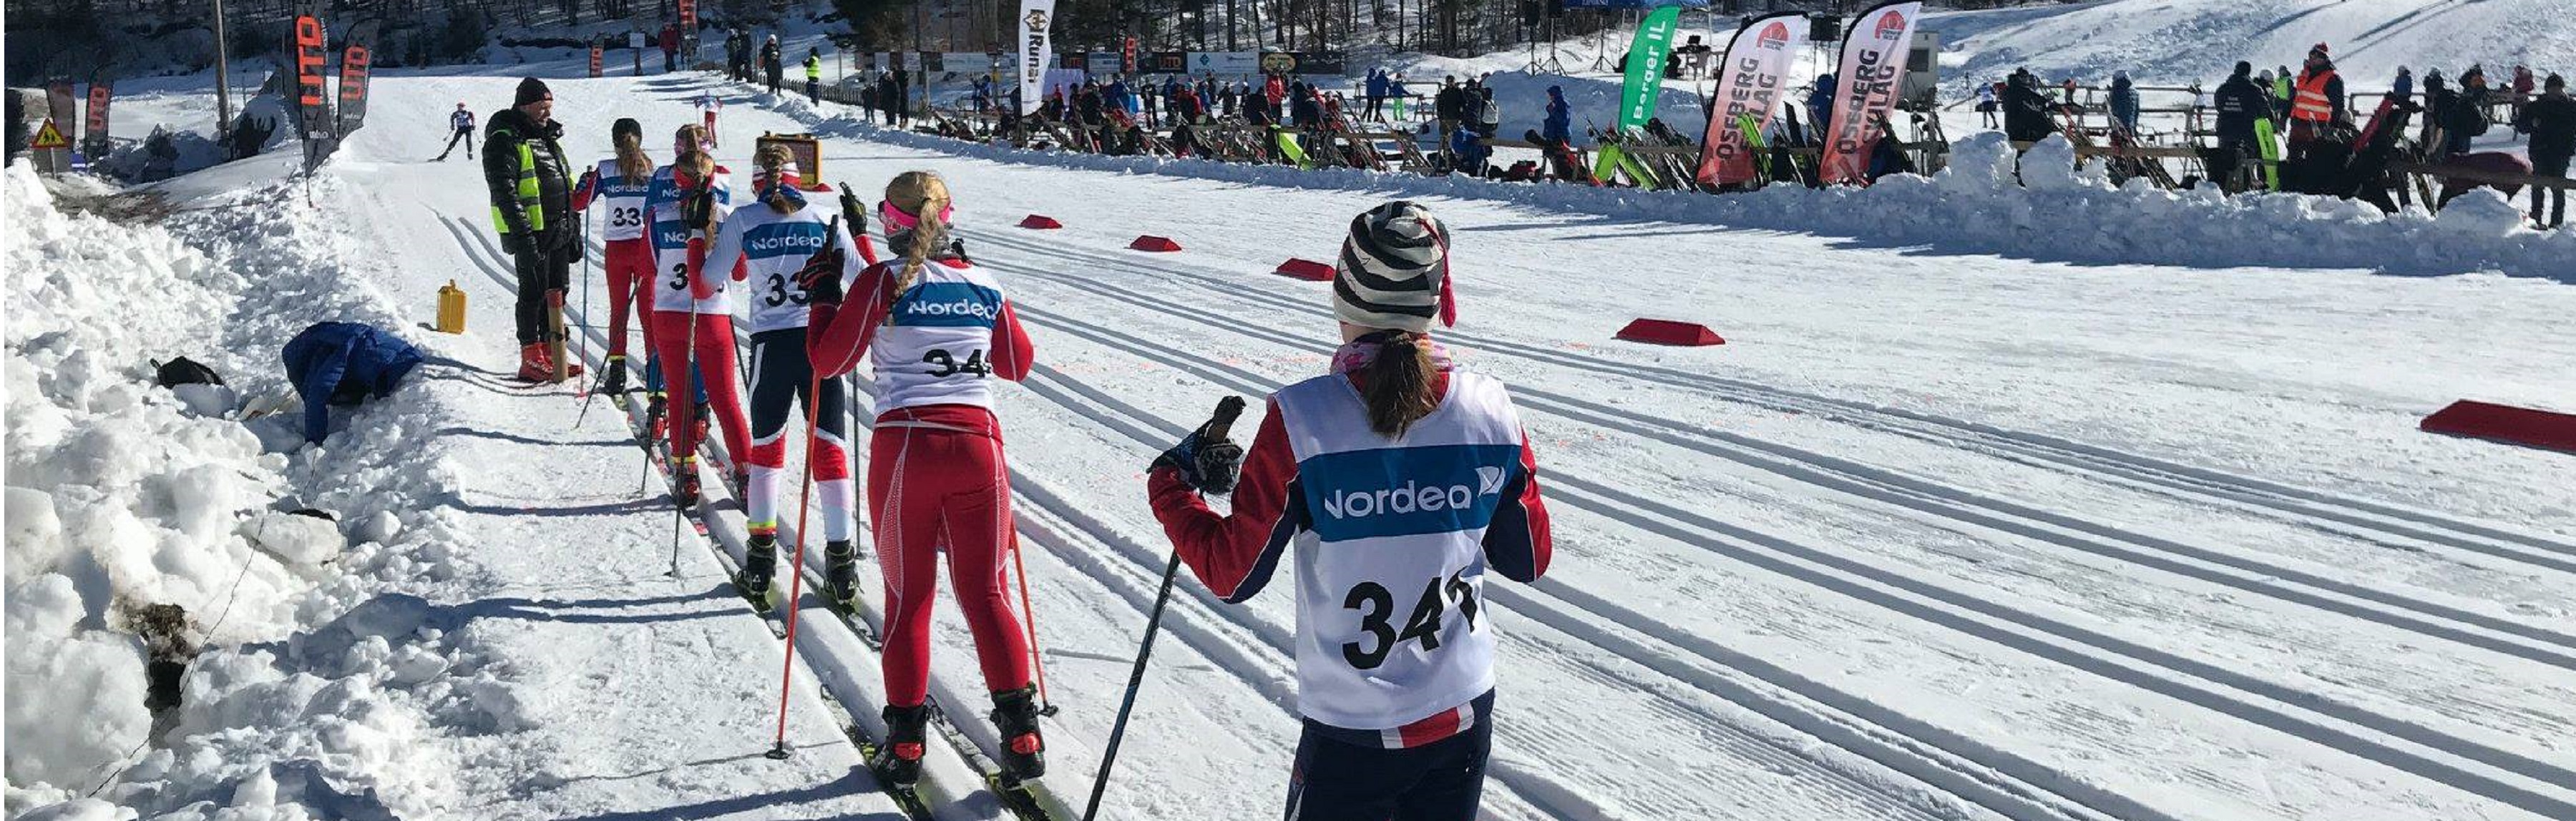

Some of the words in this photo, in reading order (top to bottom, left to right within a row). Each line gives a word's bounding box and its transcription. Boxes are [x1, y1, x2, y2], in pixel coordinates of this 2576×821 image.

[1648, 21, 1666, 41] IL
[296, 15, 324, 105] UTD
[342, 46, 368, 102] UTD
[1716, 57, 1760, 159] OSEBERG
[752, 232, 823, 251] Nordea
[908, 299, 998, 320] Nordea
[1324, 480, 1473, 520] Nordea
